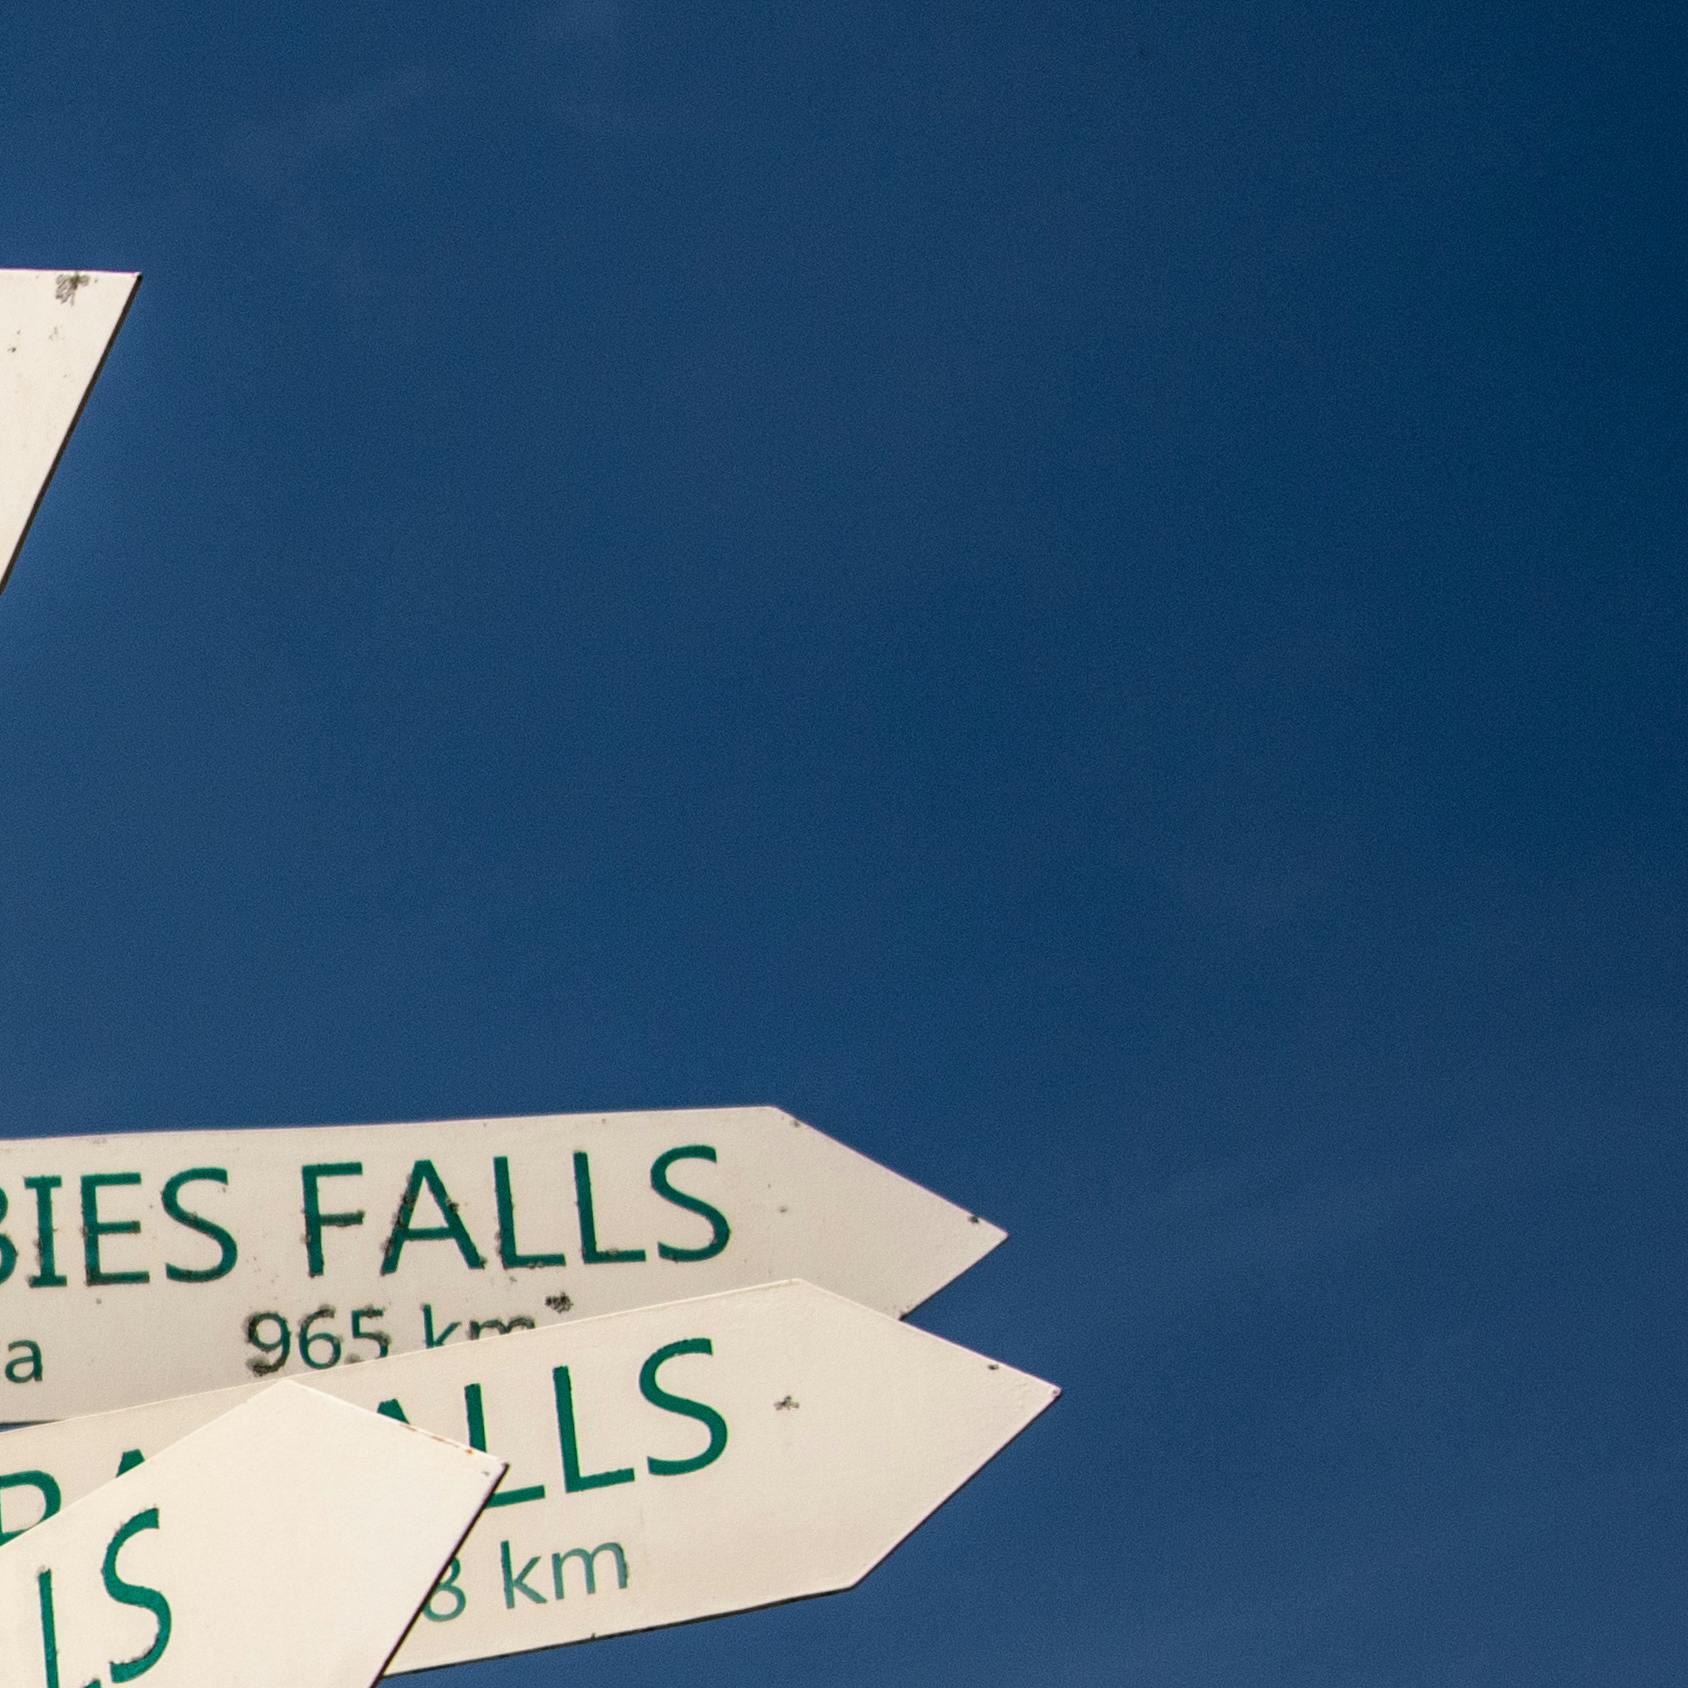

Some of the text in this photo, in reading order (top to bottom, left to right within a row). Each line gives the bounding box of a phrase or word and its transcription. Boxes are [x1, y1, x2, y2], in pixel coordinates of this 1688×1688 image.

[301, 1143, 731, 1277] FALLS
[244, 1303, 391, 1377] 965
[376, 1337, 729, 1508] LLS
[500, 1540, 629, 1611] km
